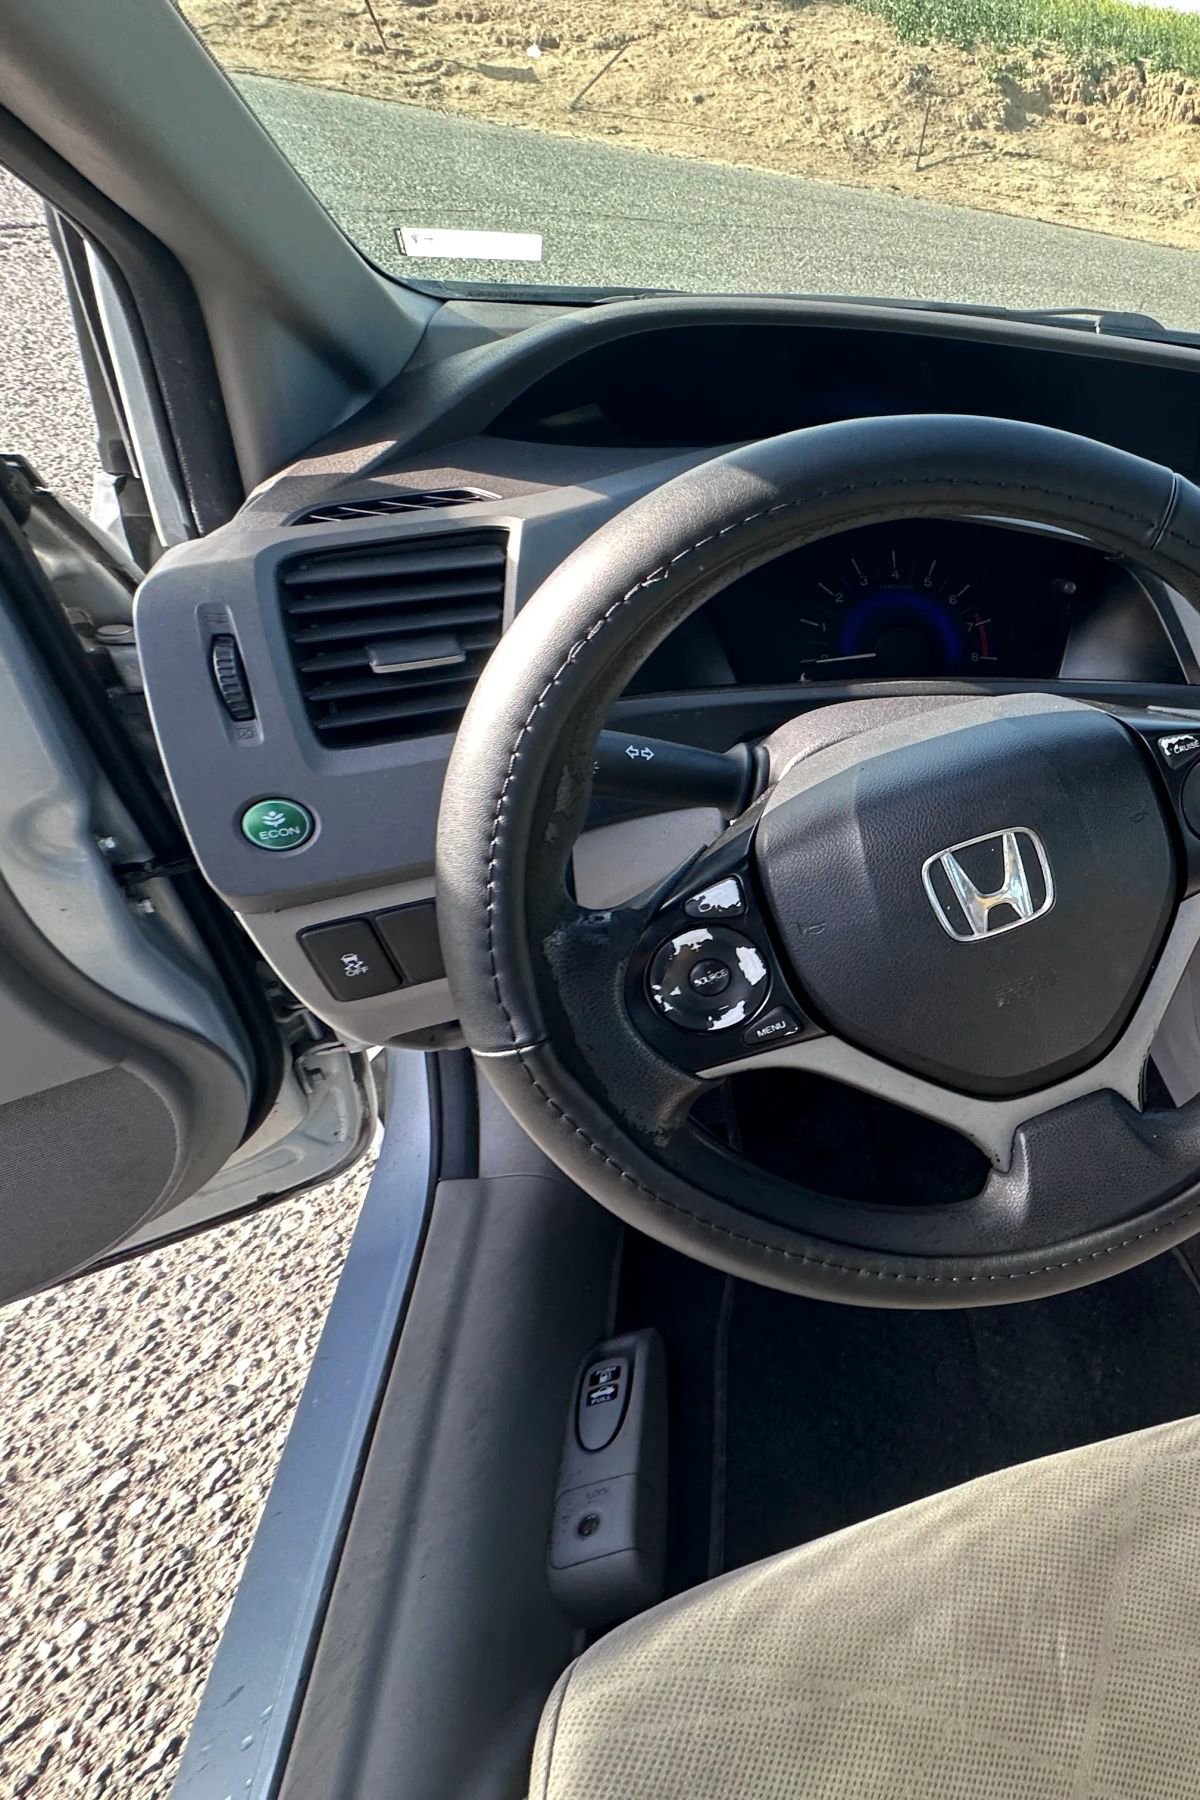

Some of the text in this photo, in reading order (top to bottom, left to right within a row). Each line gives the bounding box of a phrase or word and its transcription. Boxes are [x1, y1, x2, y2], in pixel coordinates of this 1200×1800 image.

[891, 569, 900, 580] 4
[859, 575, 869, 586] 3
[923, 577, 933, 588] 5
[835, 593, 845, 604] 2
[948, 595, 958, 606] 6
[821, 622, 827, 632] 1
[966, 622, 974, 632] 7
[1173, 740, 1200, 753] CRUISE
[258, 826, 301, 841] ECON
[345, 965, 370, 977] OFF
[693, 969, 727, 986] SOURCE
[757, 1020, 785, 1037] MENU
